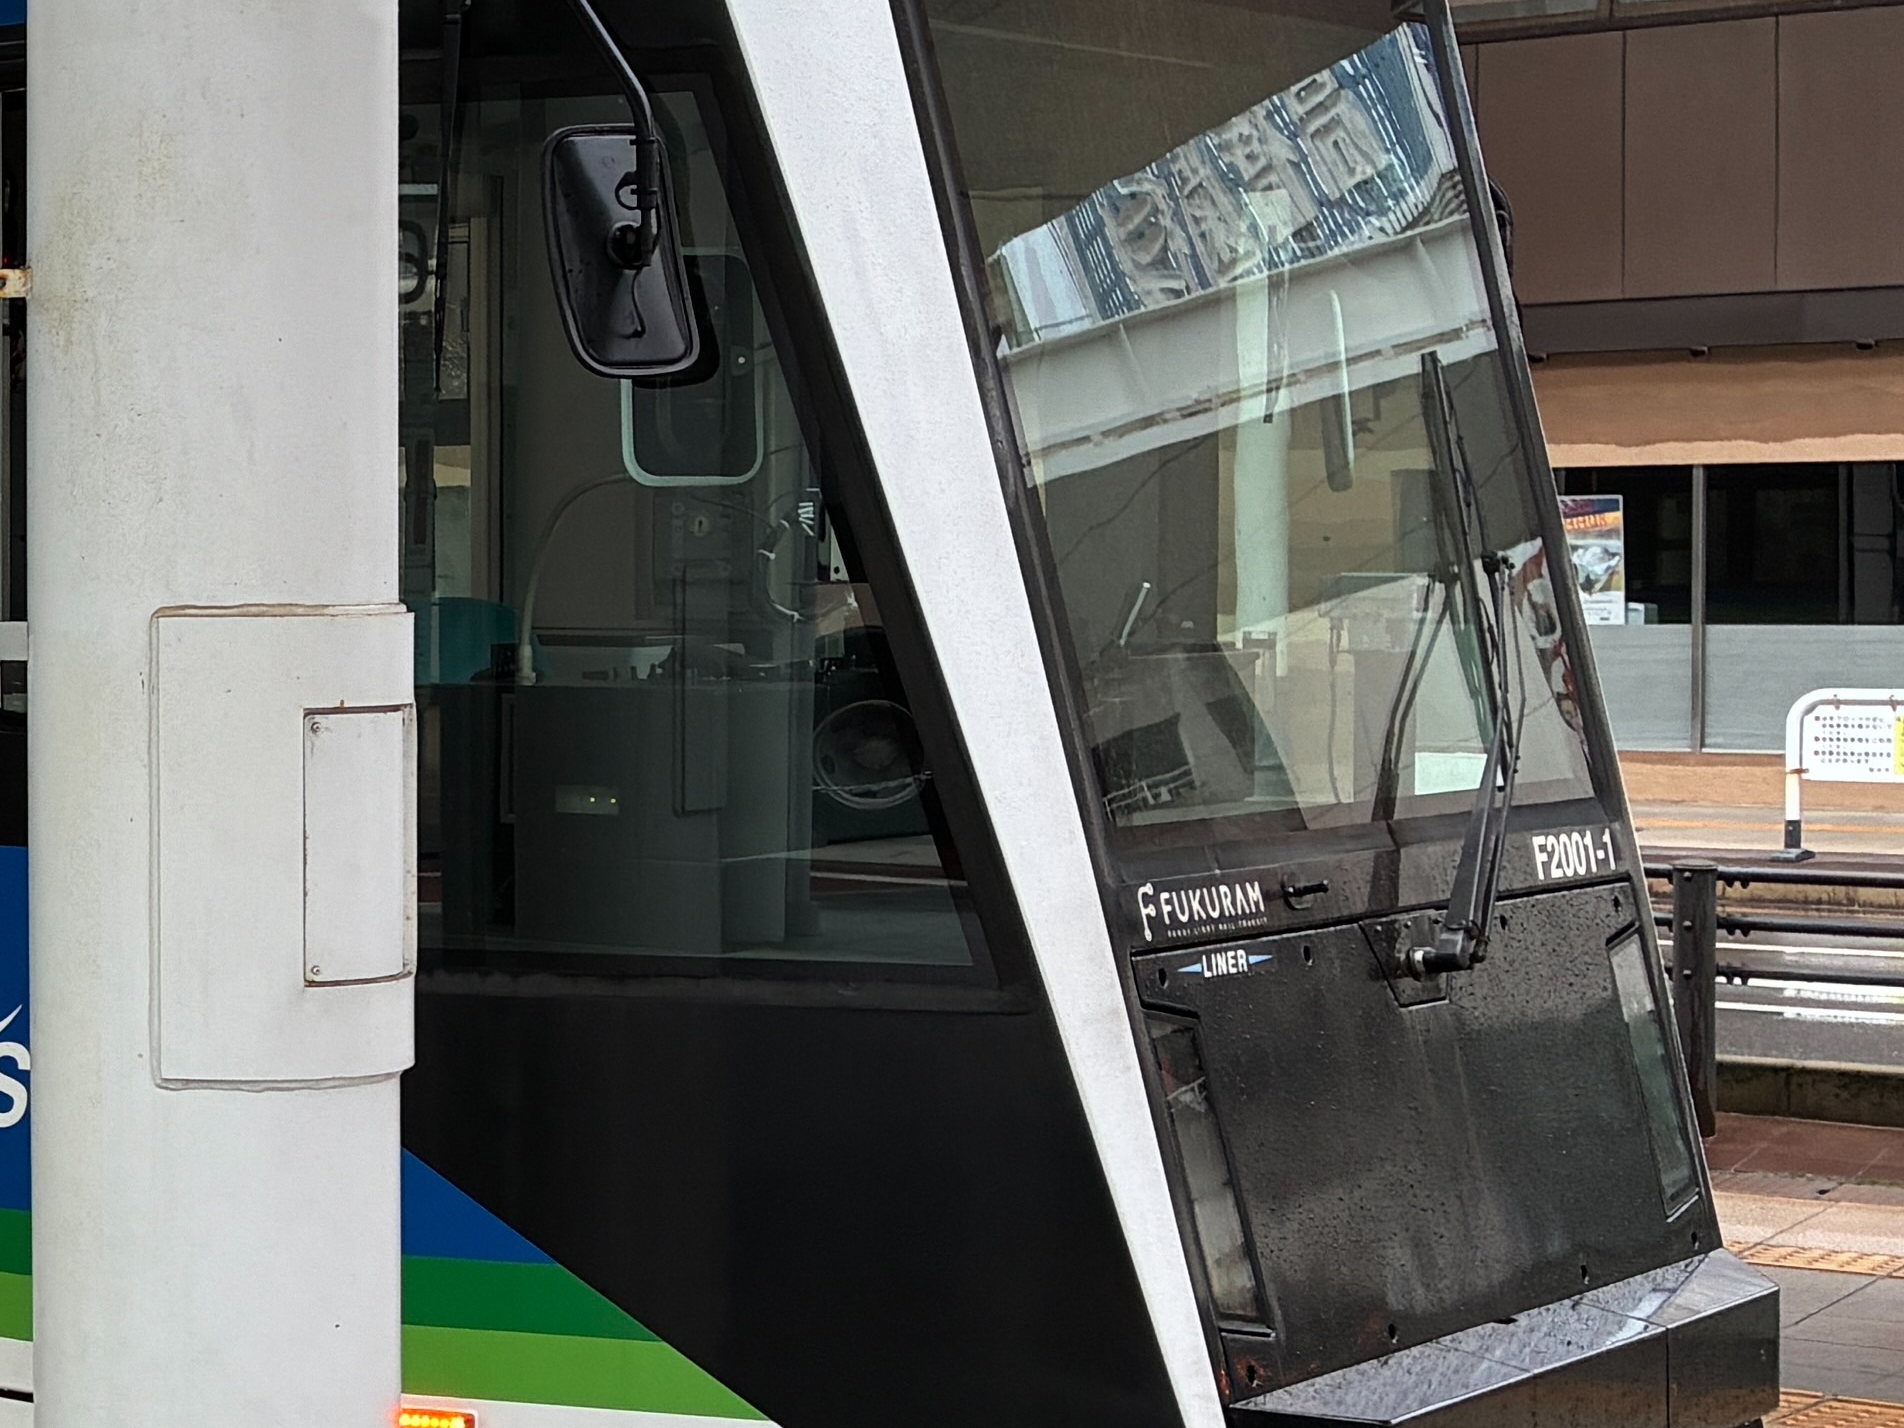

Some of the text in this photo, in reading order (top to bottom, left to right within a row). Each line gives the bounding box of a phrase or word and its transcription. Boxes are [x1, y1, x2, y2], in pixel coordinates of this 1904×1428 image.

[1531, 827, 1616, 881] F2001-1
[1159, 880, 1266, 925] FUKURAM
[1202, 949, 1249, 979] LINER
